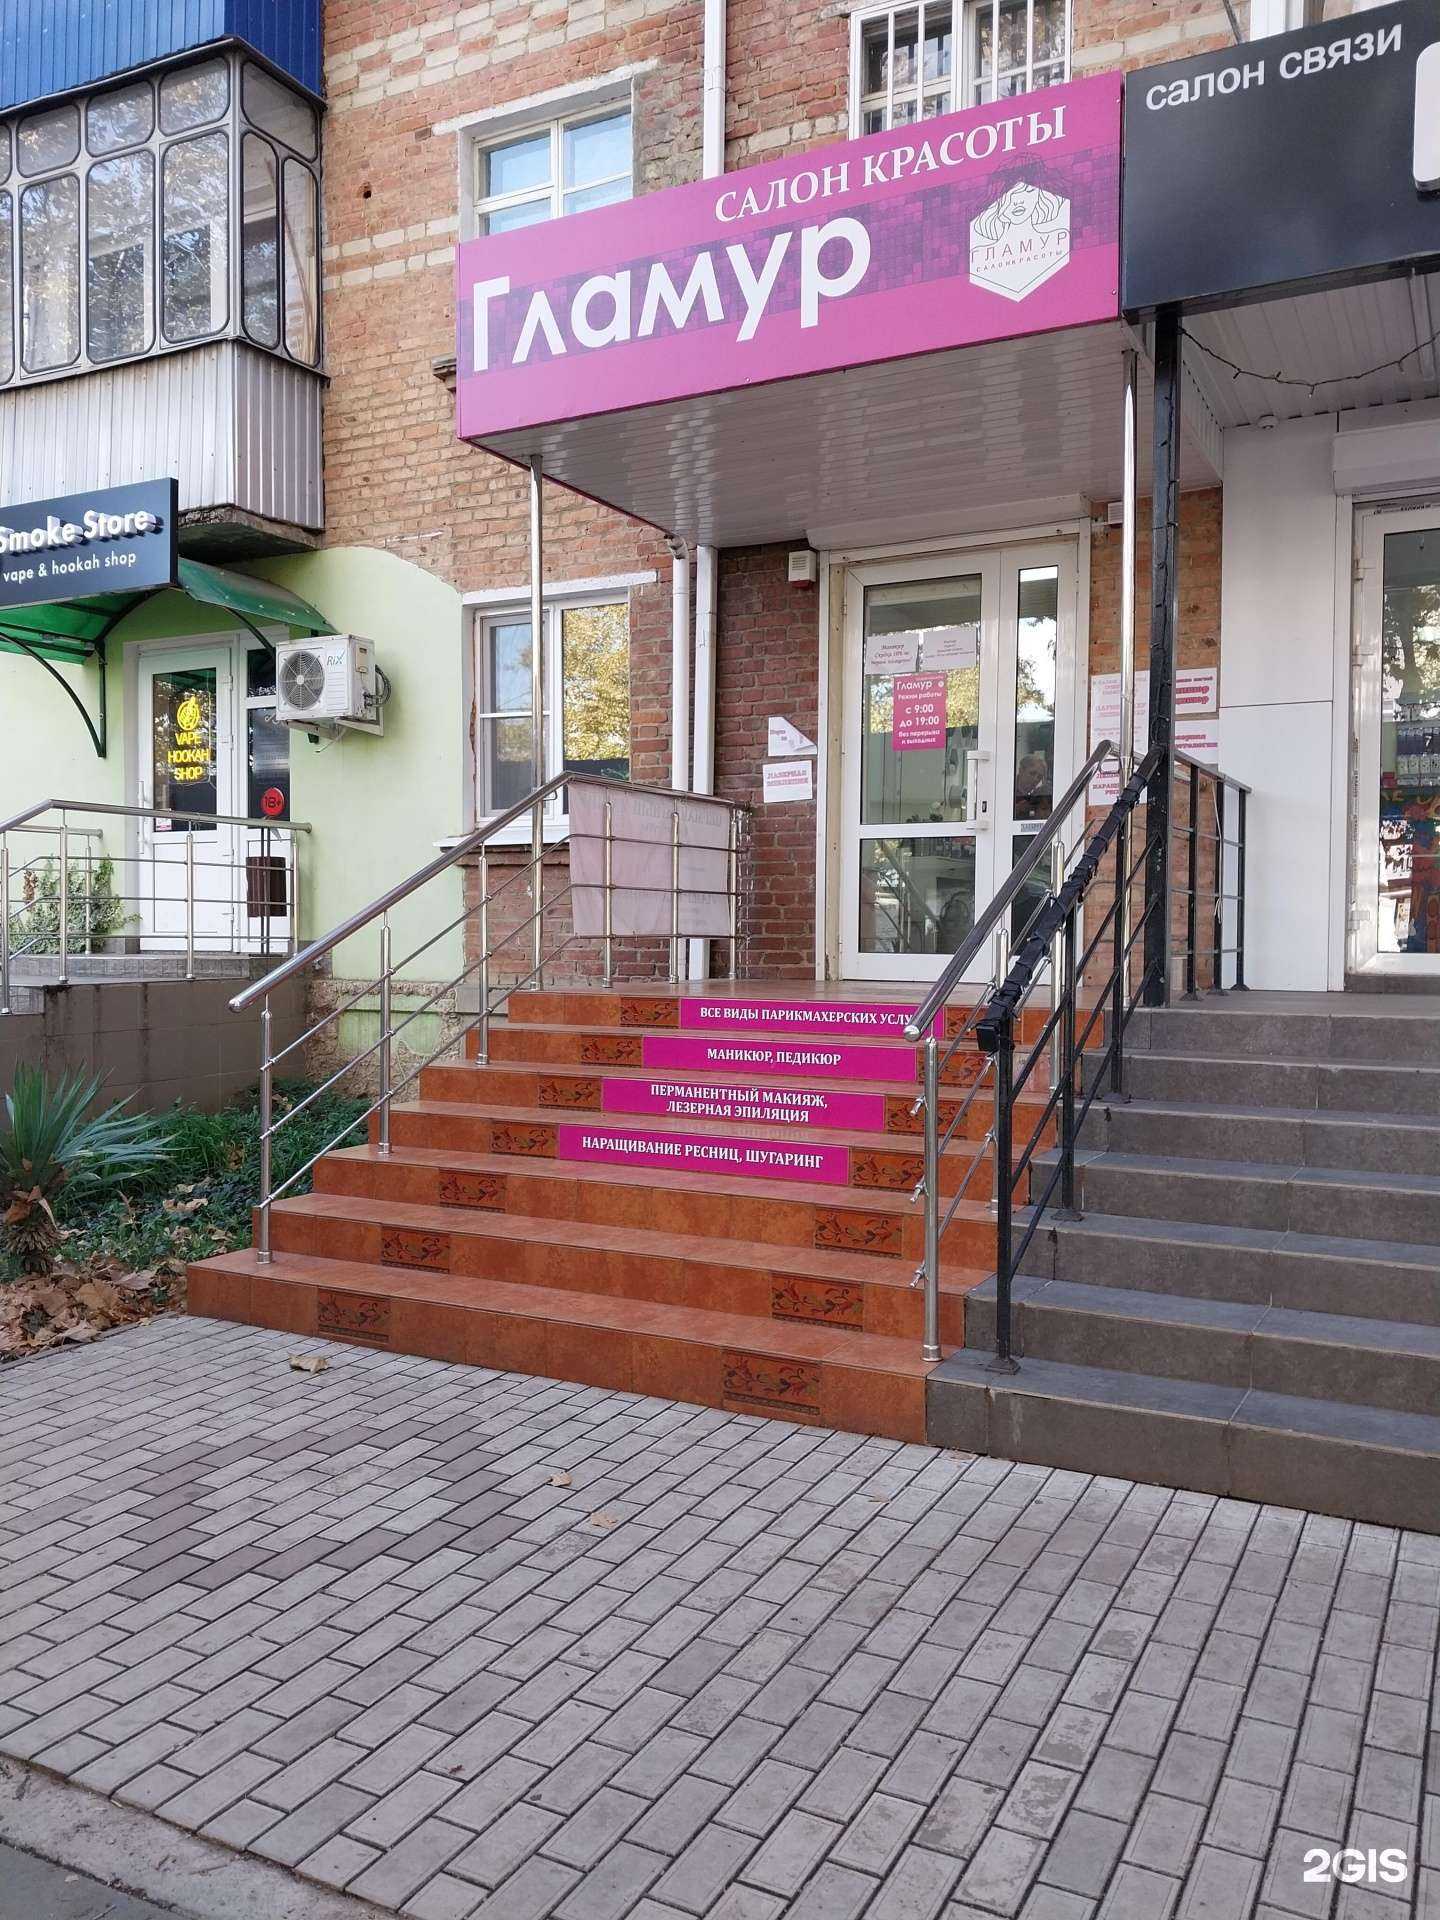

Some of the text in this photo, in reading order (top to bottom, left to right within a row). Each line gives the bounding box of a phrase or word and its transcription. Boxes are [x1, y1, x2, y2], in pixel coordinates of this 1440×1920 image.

[1146, 24, 1402, 110] салон связи
[715, 105, 1066, 222] САЛОН КРАСОТЫ
[971, 231, 1067, 263] ГЛАМУР
[473, 217, 871, 372] Гламур
[0, 510, 157, 553] Smoke Store
[3, 551, 137, 584] vape & hookah shop
[896, 681, 933, 691] Гламур
[914, 704, 934, 714] 9:00
[916, 716, 940, 726] 19:00
[175, 731, 203, 745] VAPE
[168, 748, 209, 763] HOOKAH
[174, 766, 203, 781] SHOP
[700, 1007, 913, 1026] ВСЕ ВИДЫ ПАРИКМАХЕРСКИХ УСЛУ
[707, 1048, 841, 1067] МАНИКЮР, ПЕДИКЮР
[650, 1084, 828, 1109] ПЕРМАНЕНТНЫЙ МАКИЯЖ,
[666, 1100, 809, 1123] ЛЕЗЕРНАЯ ЭПИЛЯЦИЯ
[582, 1136, 824, 1169] НАРАЩИВАНИЕ РЕСНИЦ, ШУГАРИНГ
